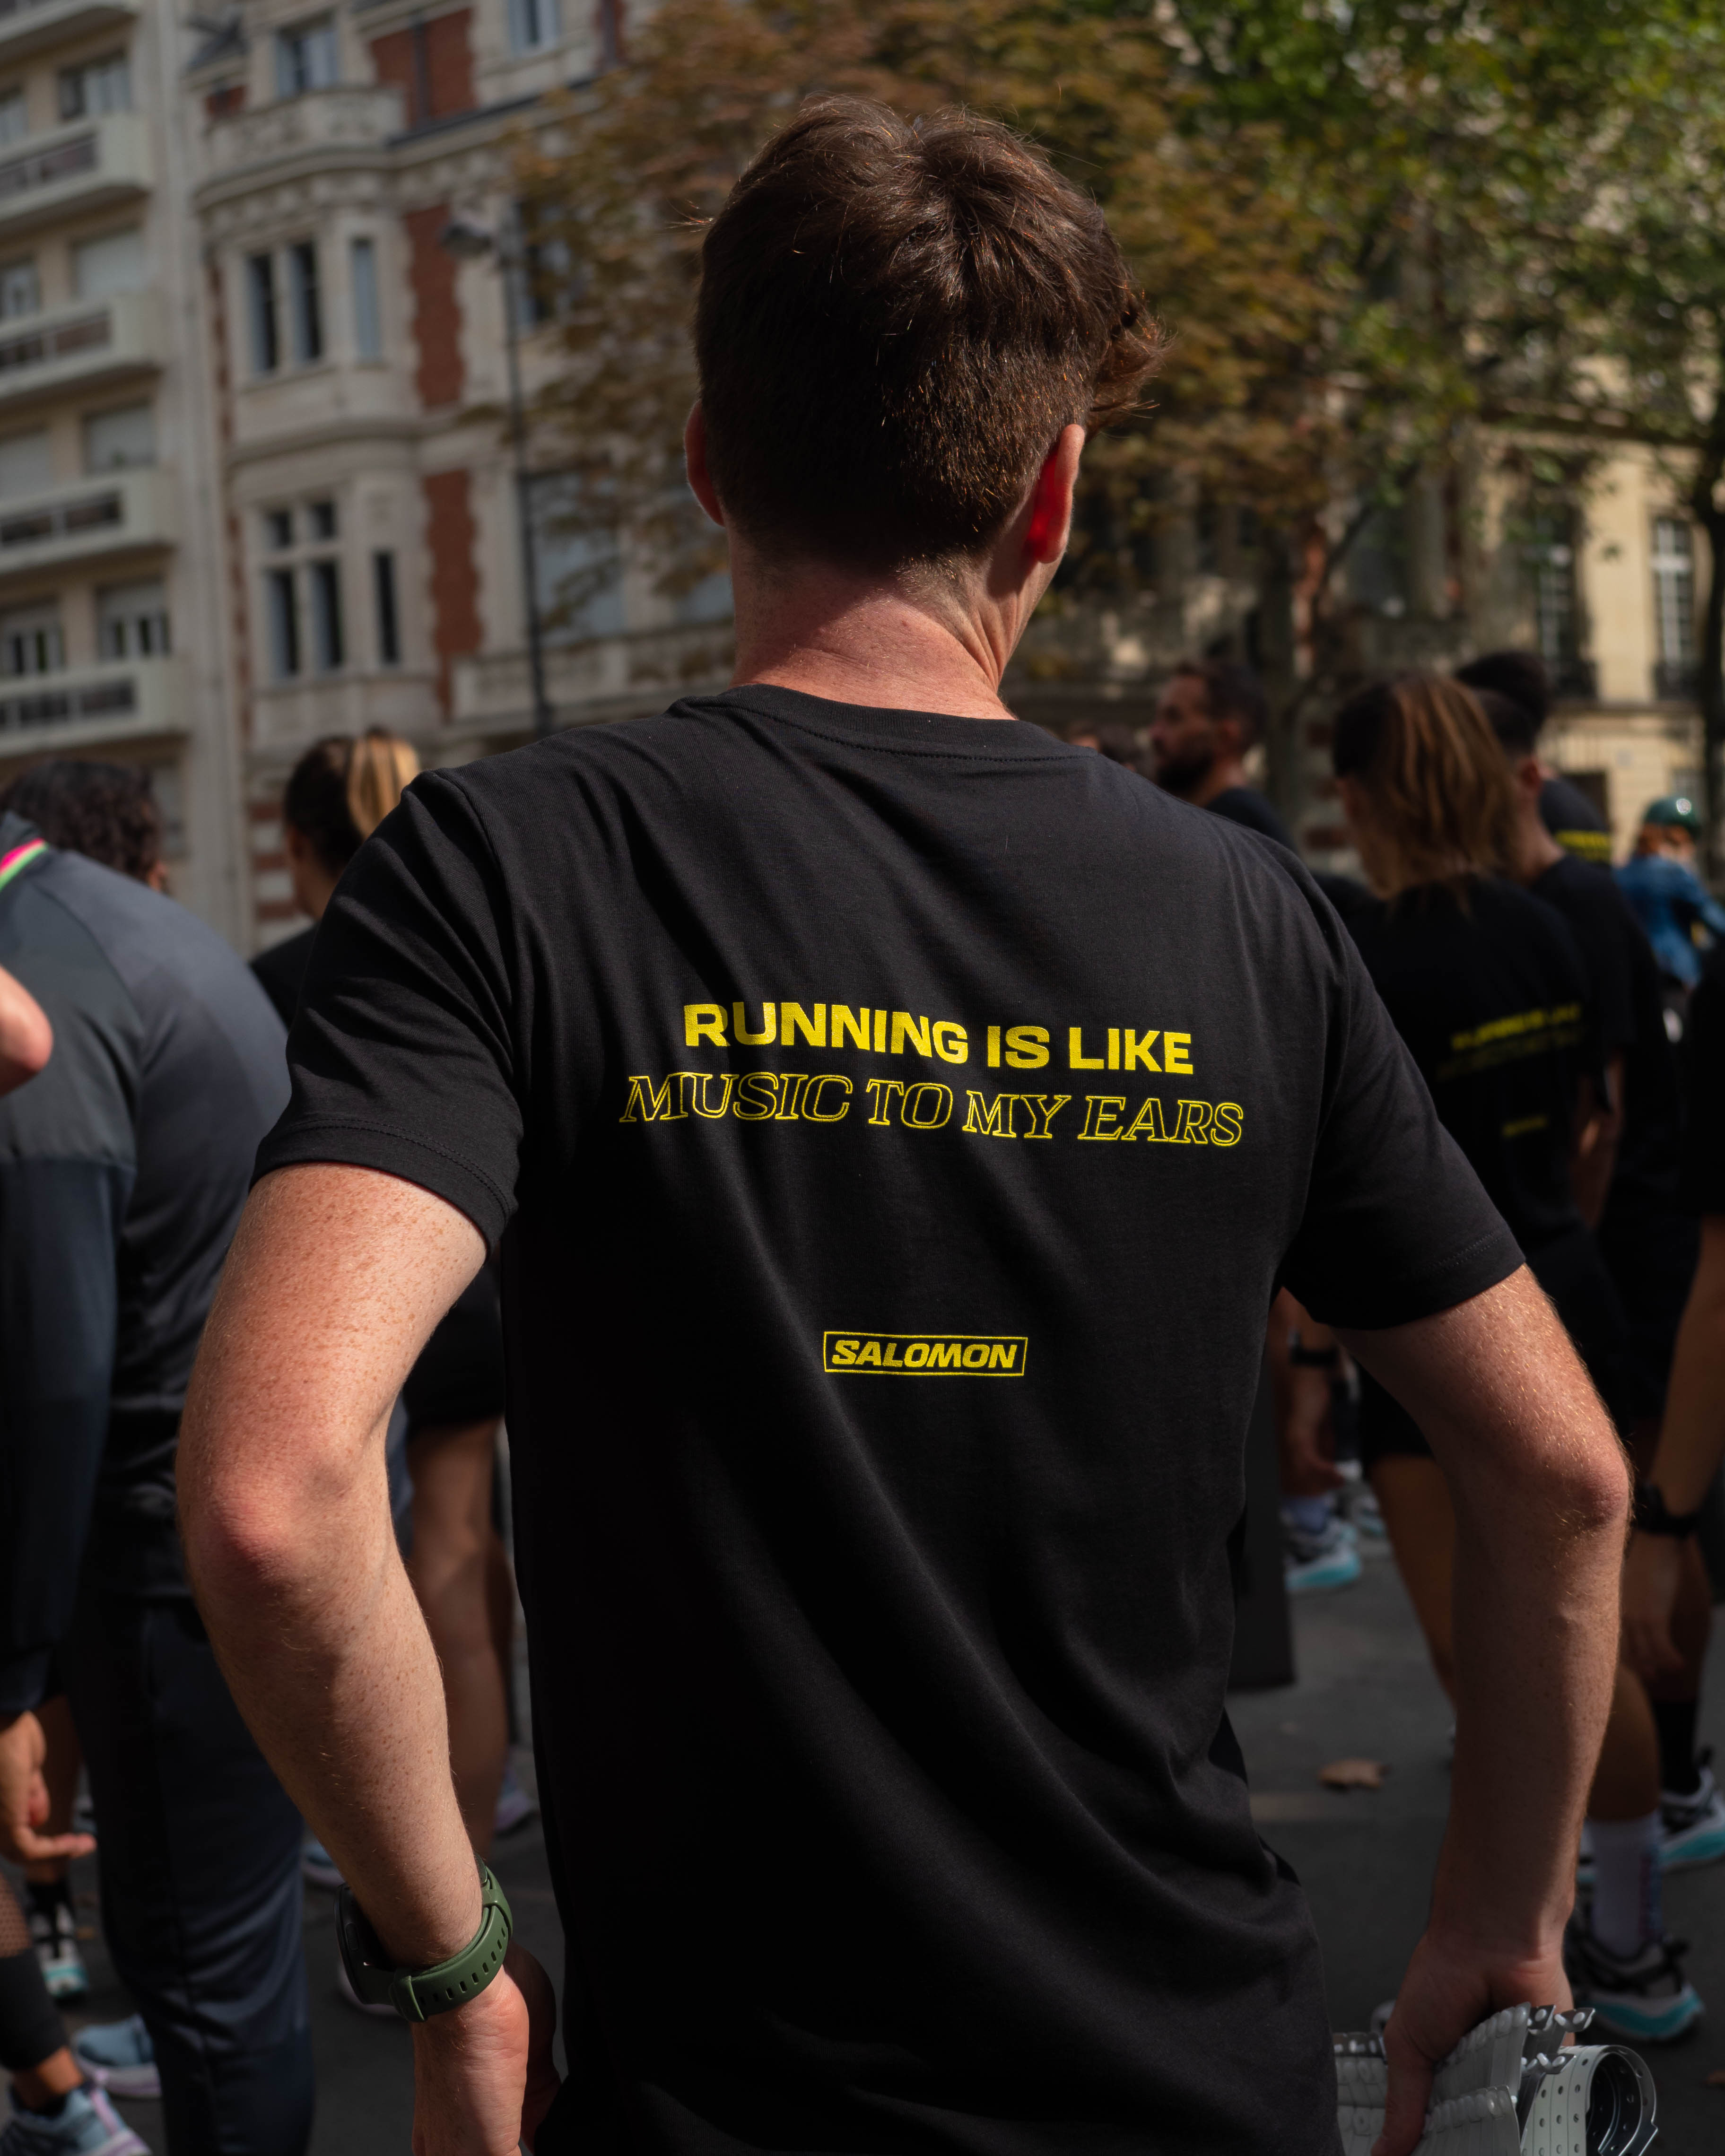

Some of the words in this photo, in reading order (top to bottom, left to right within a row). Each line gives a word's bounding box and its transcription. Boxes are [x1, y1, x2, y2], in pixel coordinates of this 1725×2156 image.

[684, 1002, 968, 1064] RUNNING
[987, 1026, 1050, 1069] IS
[1069, 1027, 1194, 1075] LIKE
[619, 1072, 853, 1122] MUSIC
[866, 1078, 953, 1129] TO
[962, 1090, 1072, 1139] MY
[1078, 1095, 1244, 1147] EARS
[831, 1340, 1018, 1368] SALOMON
